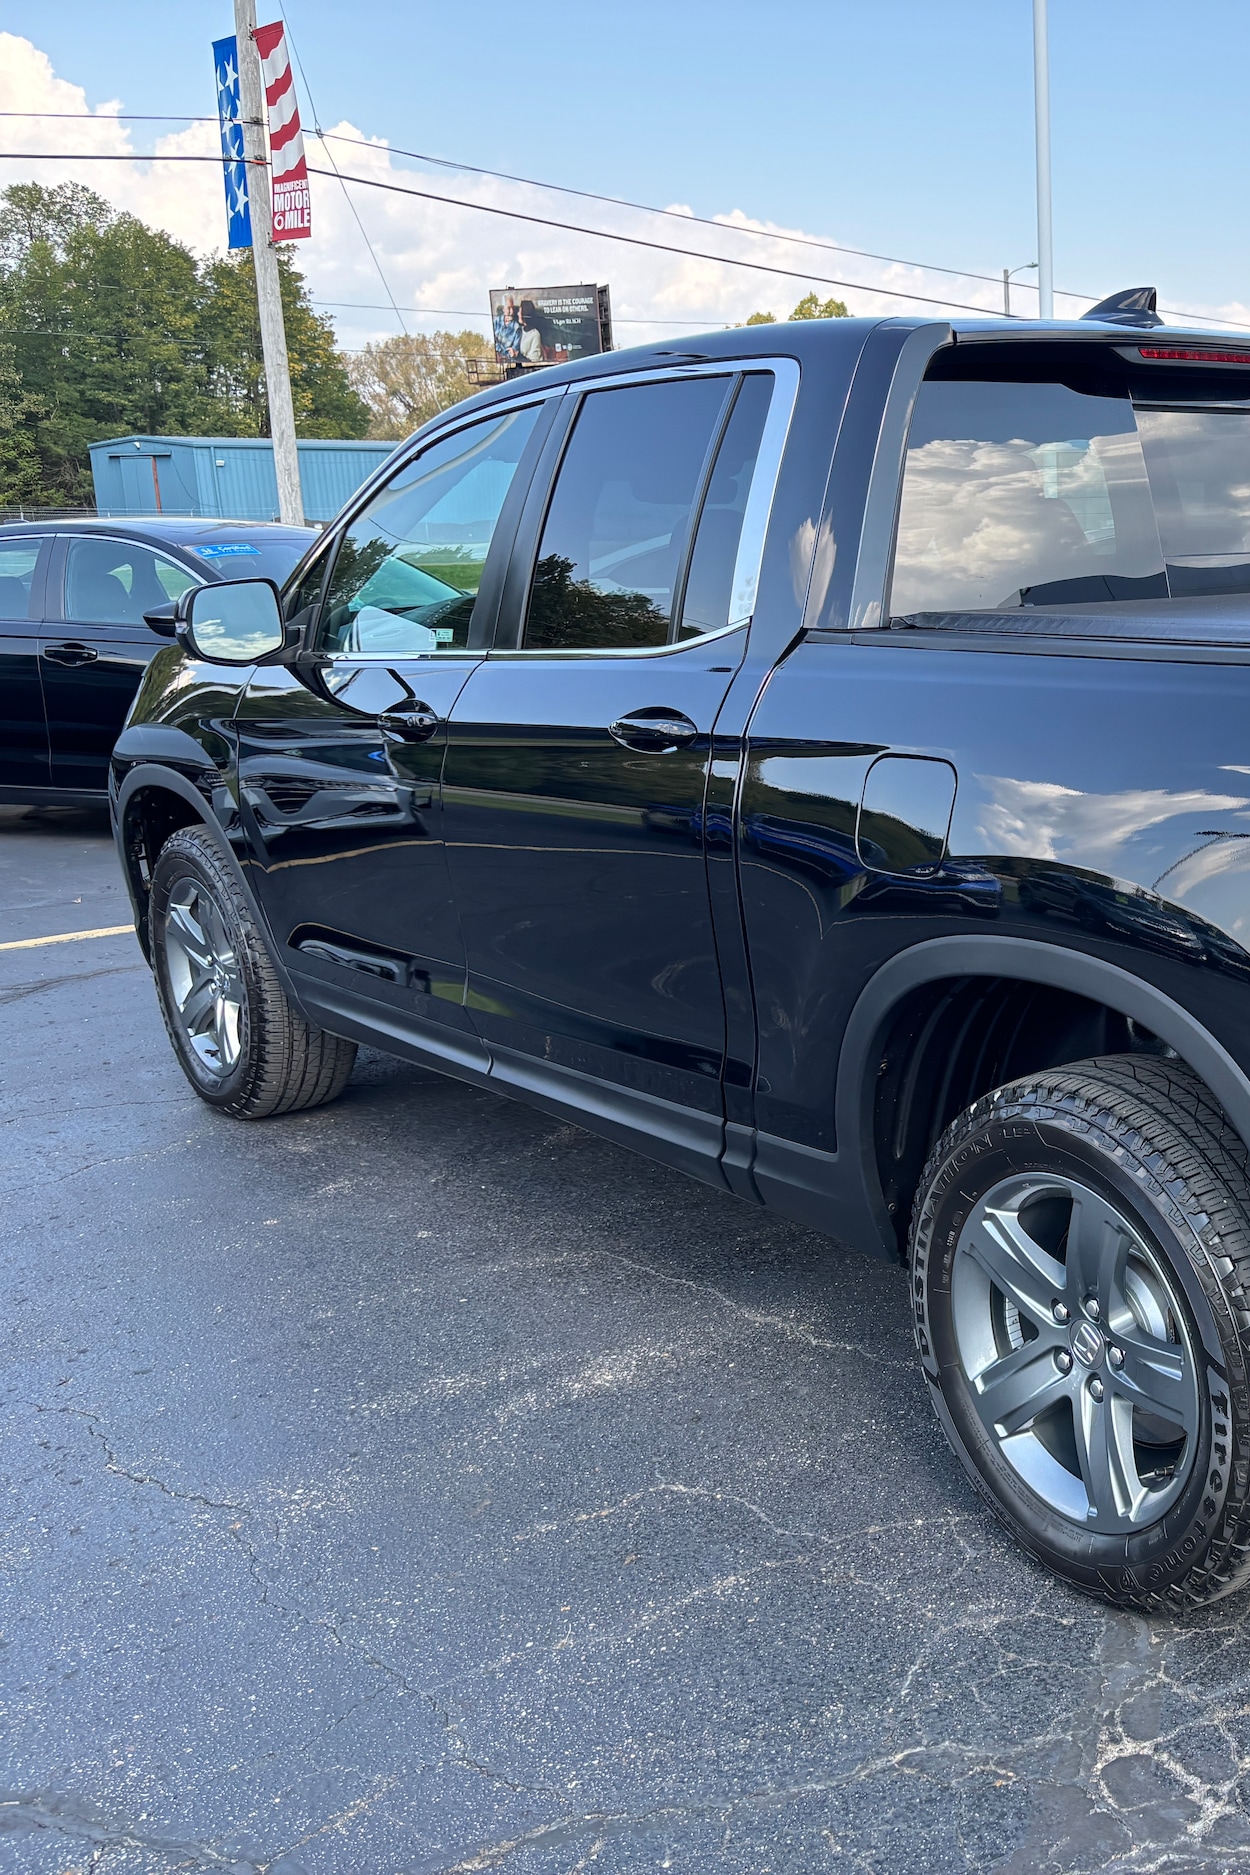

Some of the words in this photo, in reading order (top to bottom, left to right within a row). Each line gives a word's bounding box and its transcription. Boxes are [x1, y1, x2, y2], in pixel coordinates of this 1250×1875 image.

[274, 190, 310, 212] MOTOR
[285, 209, 311, 229] MILE
[572, 297, 594, 305] COURAGE
[914, 1133, 993, 1358] DESTINATION
[1150, 1390, 1230, 1582] Firestone
